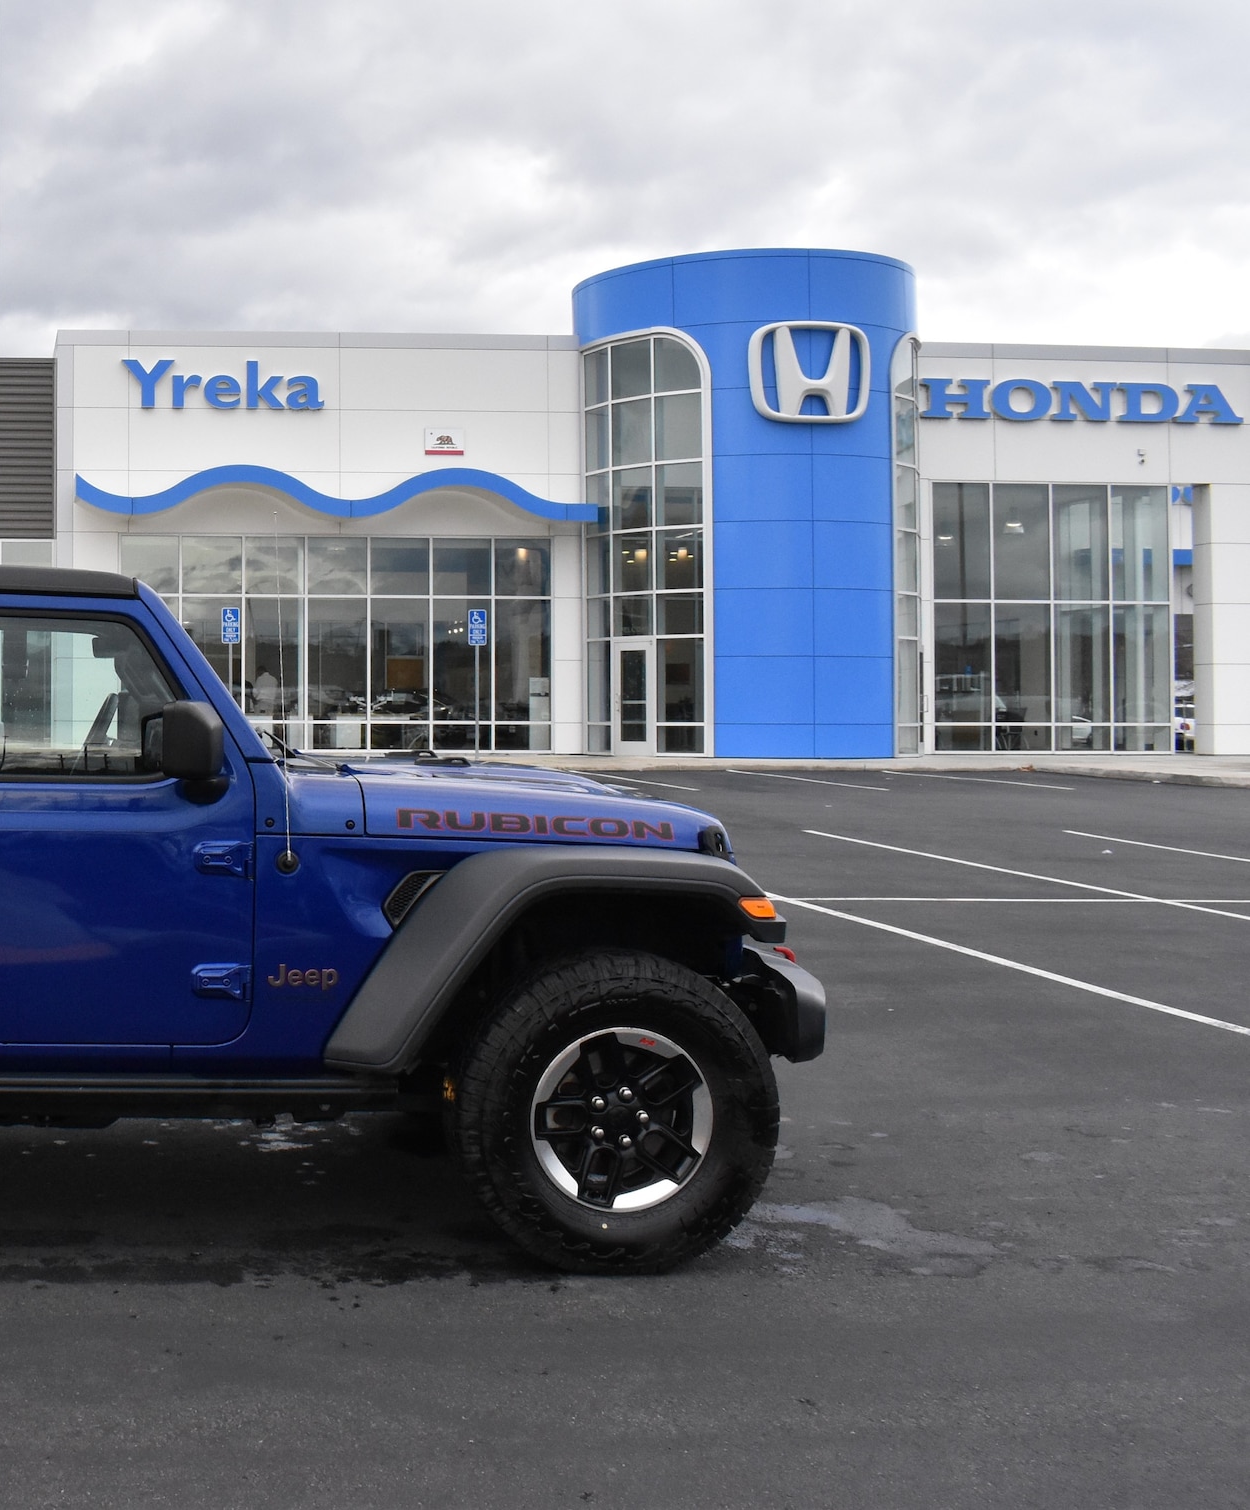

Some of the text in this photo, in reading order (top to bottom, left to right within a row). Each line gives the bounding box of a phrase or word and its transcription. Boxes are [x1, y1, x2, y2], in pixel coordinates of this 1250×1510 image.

[121, 359, 325, 410] Yreka
[918, 376, 1245, 425] HONDA
[396, 807, 675, 841] RUBICON
[267, 963, 339, 991] Jeep
